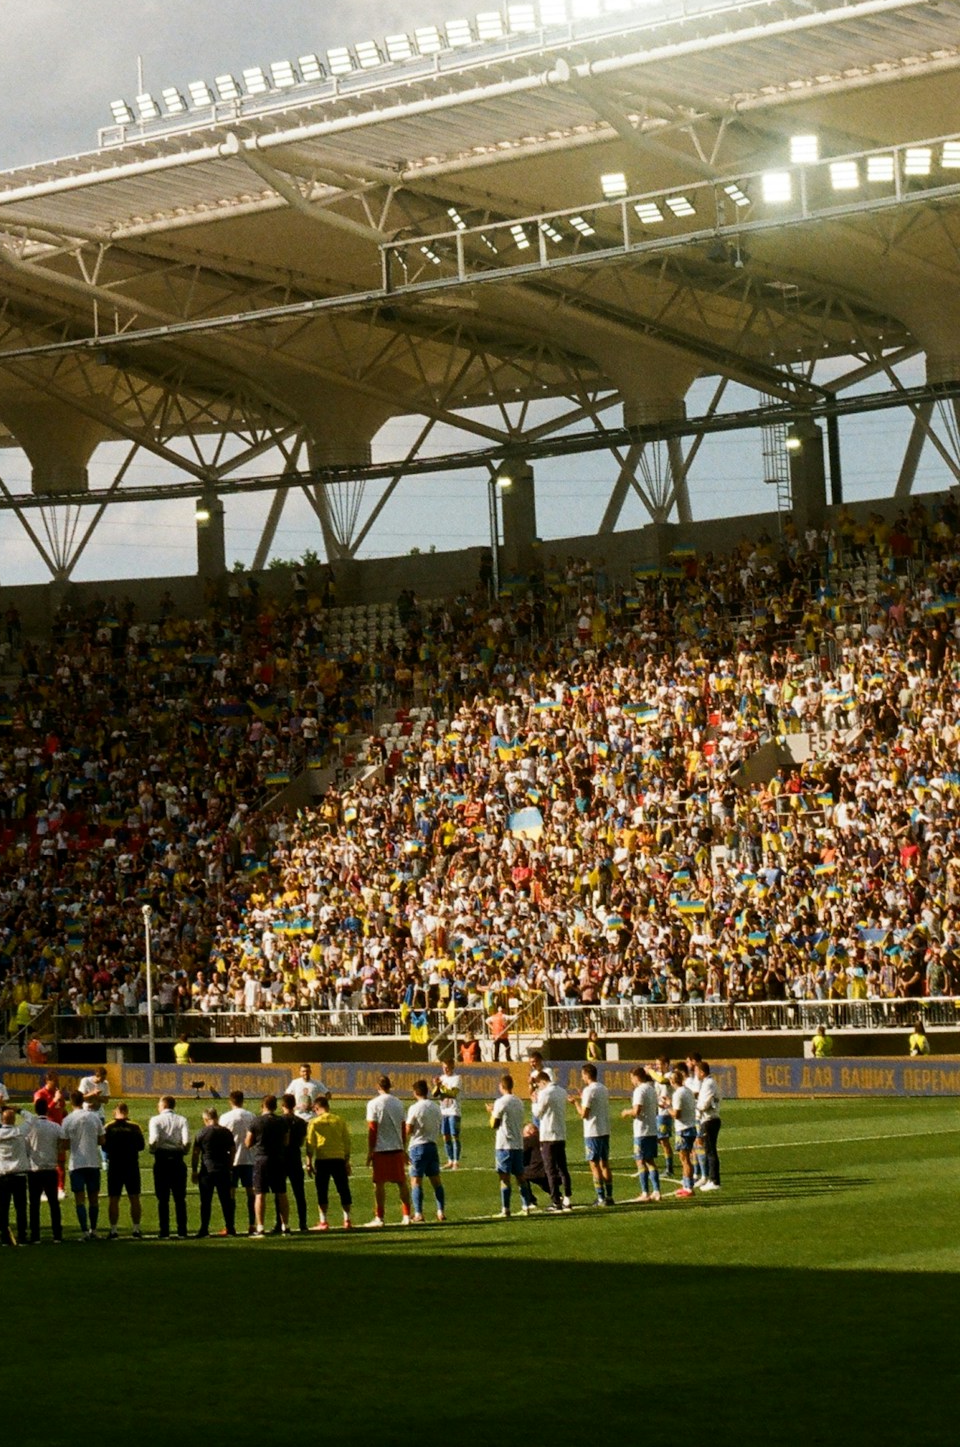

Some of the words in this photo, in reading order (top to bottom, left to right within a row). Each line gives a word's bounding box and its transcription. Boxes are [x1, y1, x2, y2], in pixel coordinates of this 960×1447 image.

[808, 733, 827, 752] E5
[335, 768, 351, 785] F6
[765, 1065, 791, 1087] ВСЕ
[799, 1066, 833, 1088] ДЛЯ
[841, 1067, 896, 1090] ВАШИХ
